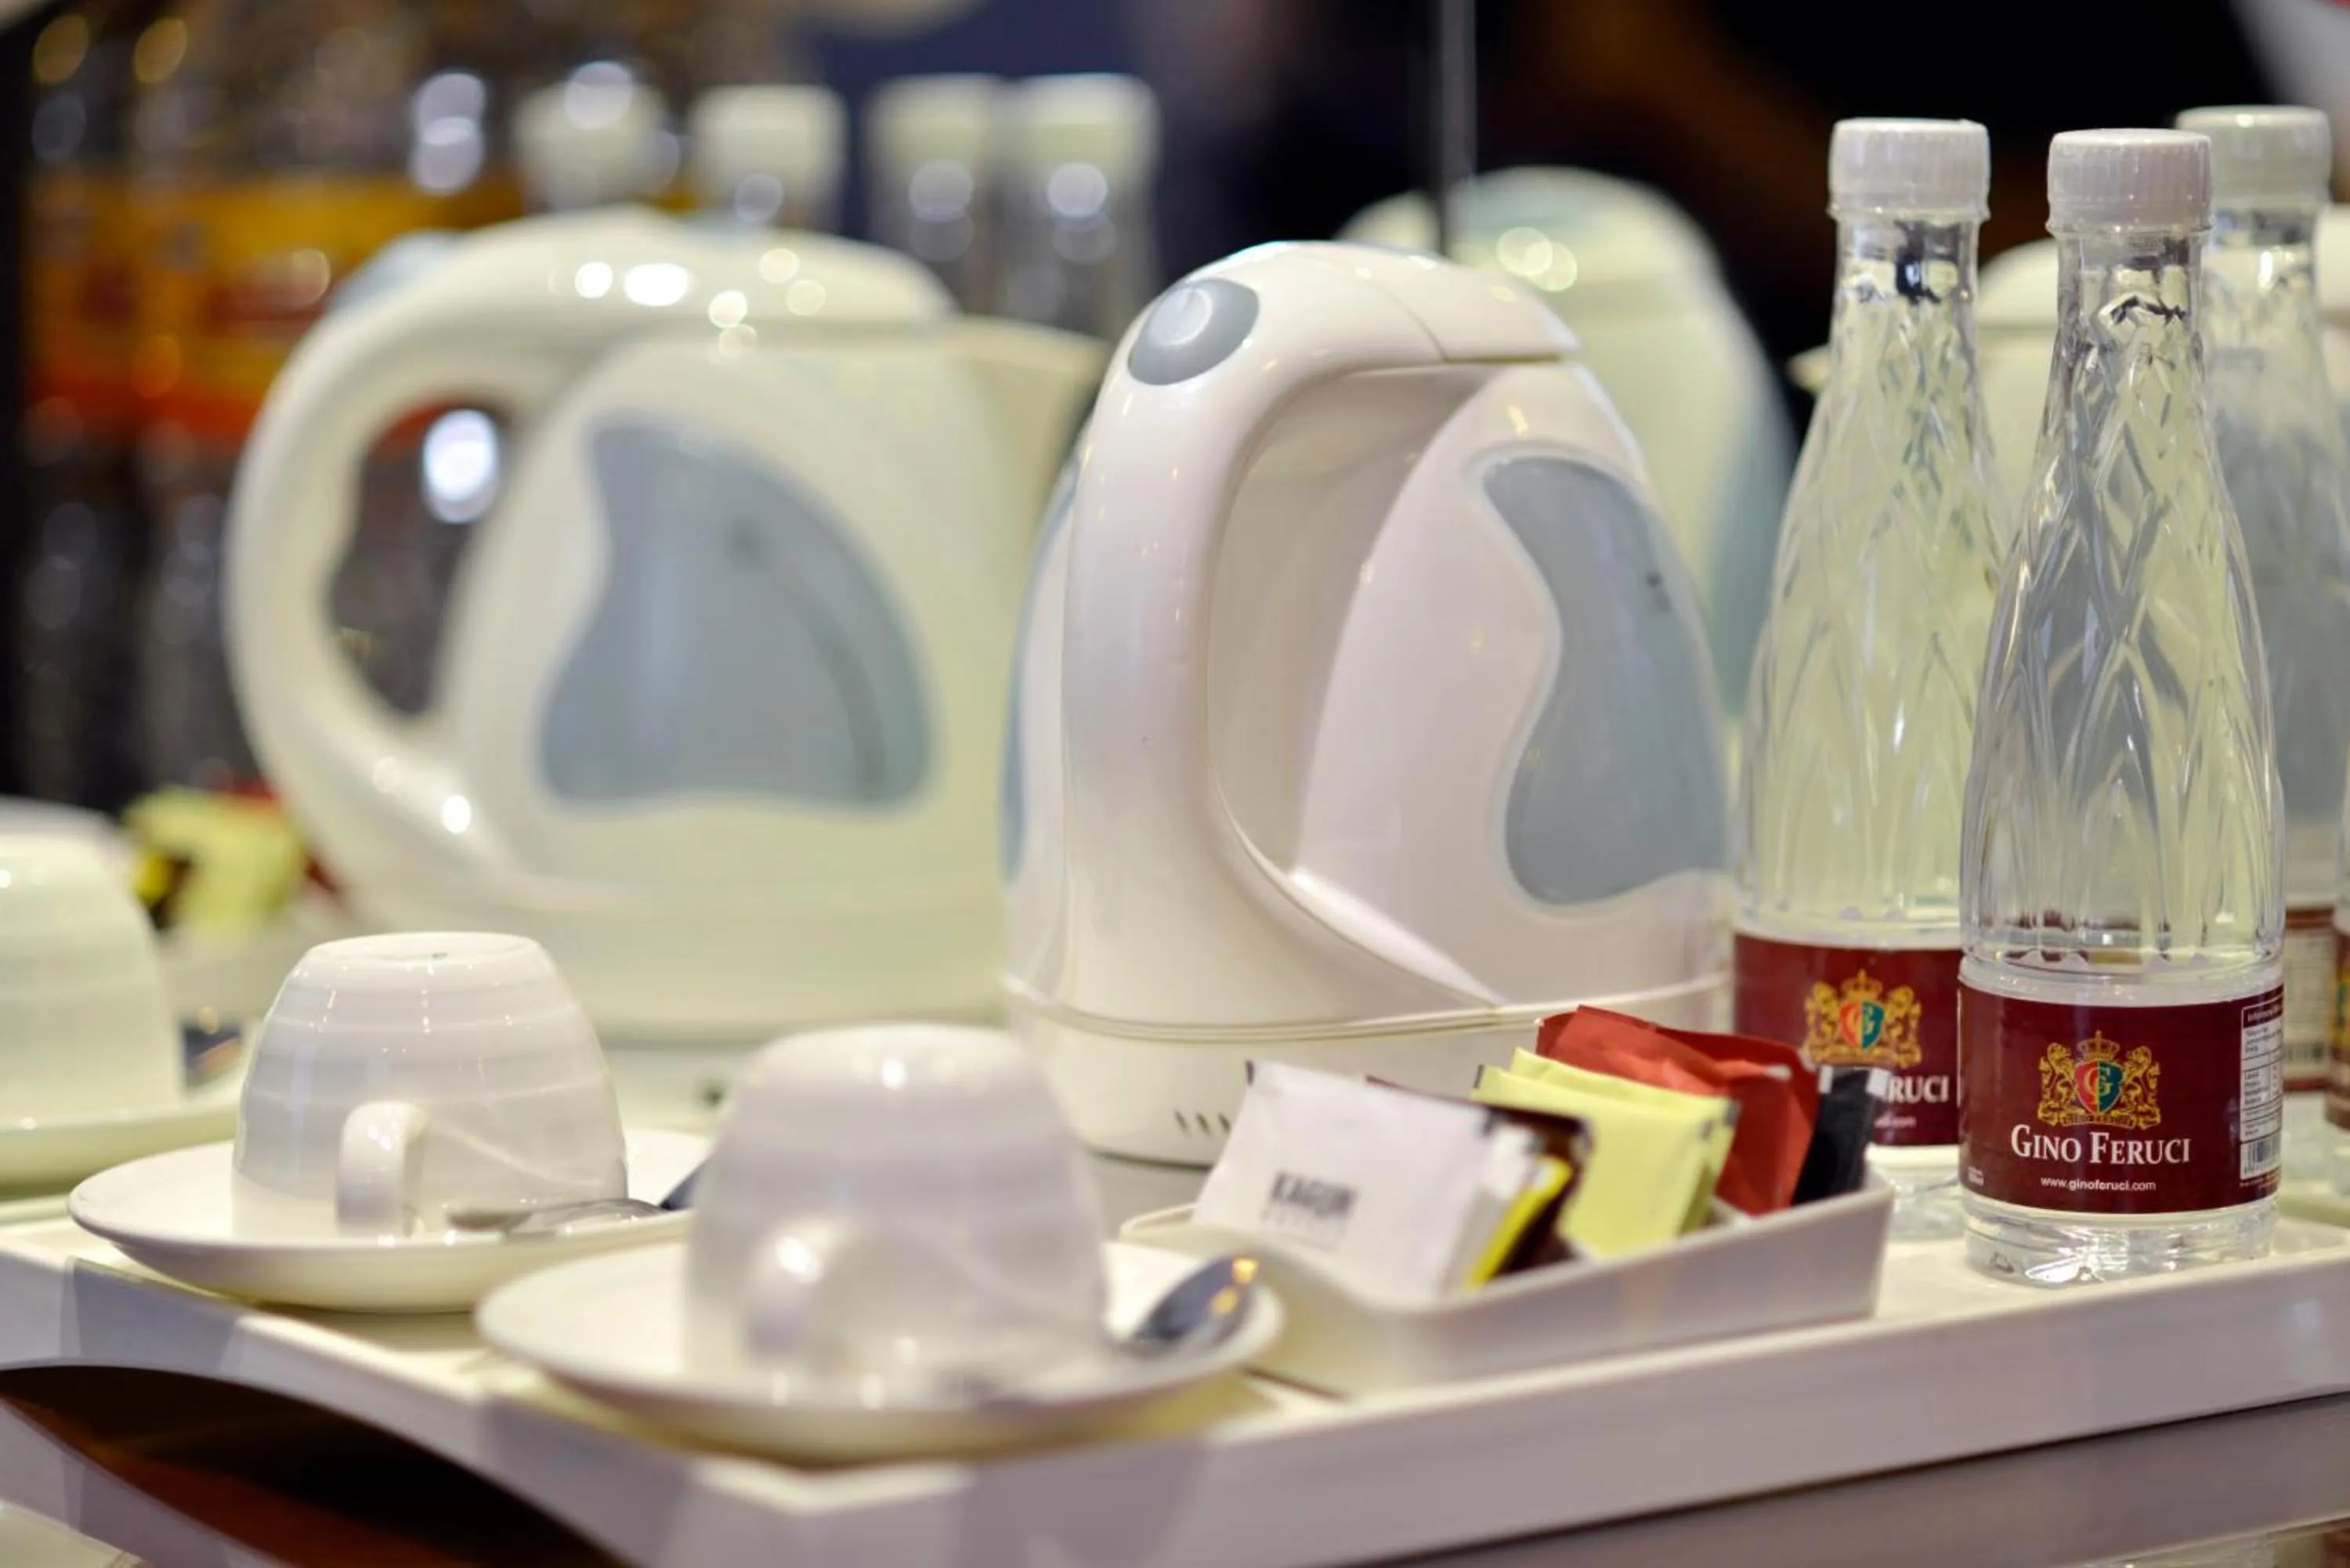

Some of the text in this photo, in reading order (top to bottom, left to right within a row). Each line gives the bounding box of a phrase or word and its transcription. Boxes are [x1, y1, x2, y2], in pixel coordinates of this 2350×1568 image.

[1888, 1075, 1949, 1104] RUCI
[2011, 1124, 2192, 1165] GINO FERUCI
[2041, 1177, 2157, 1191] www.ginoferuci.com
